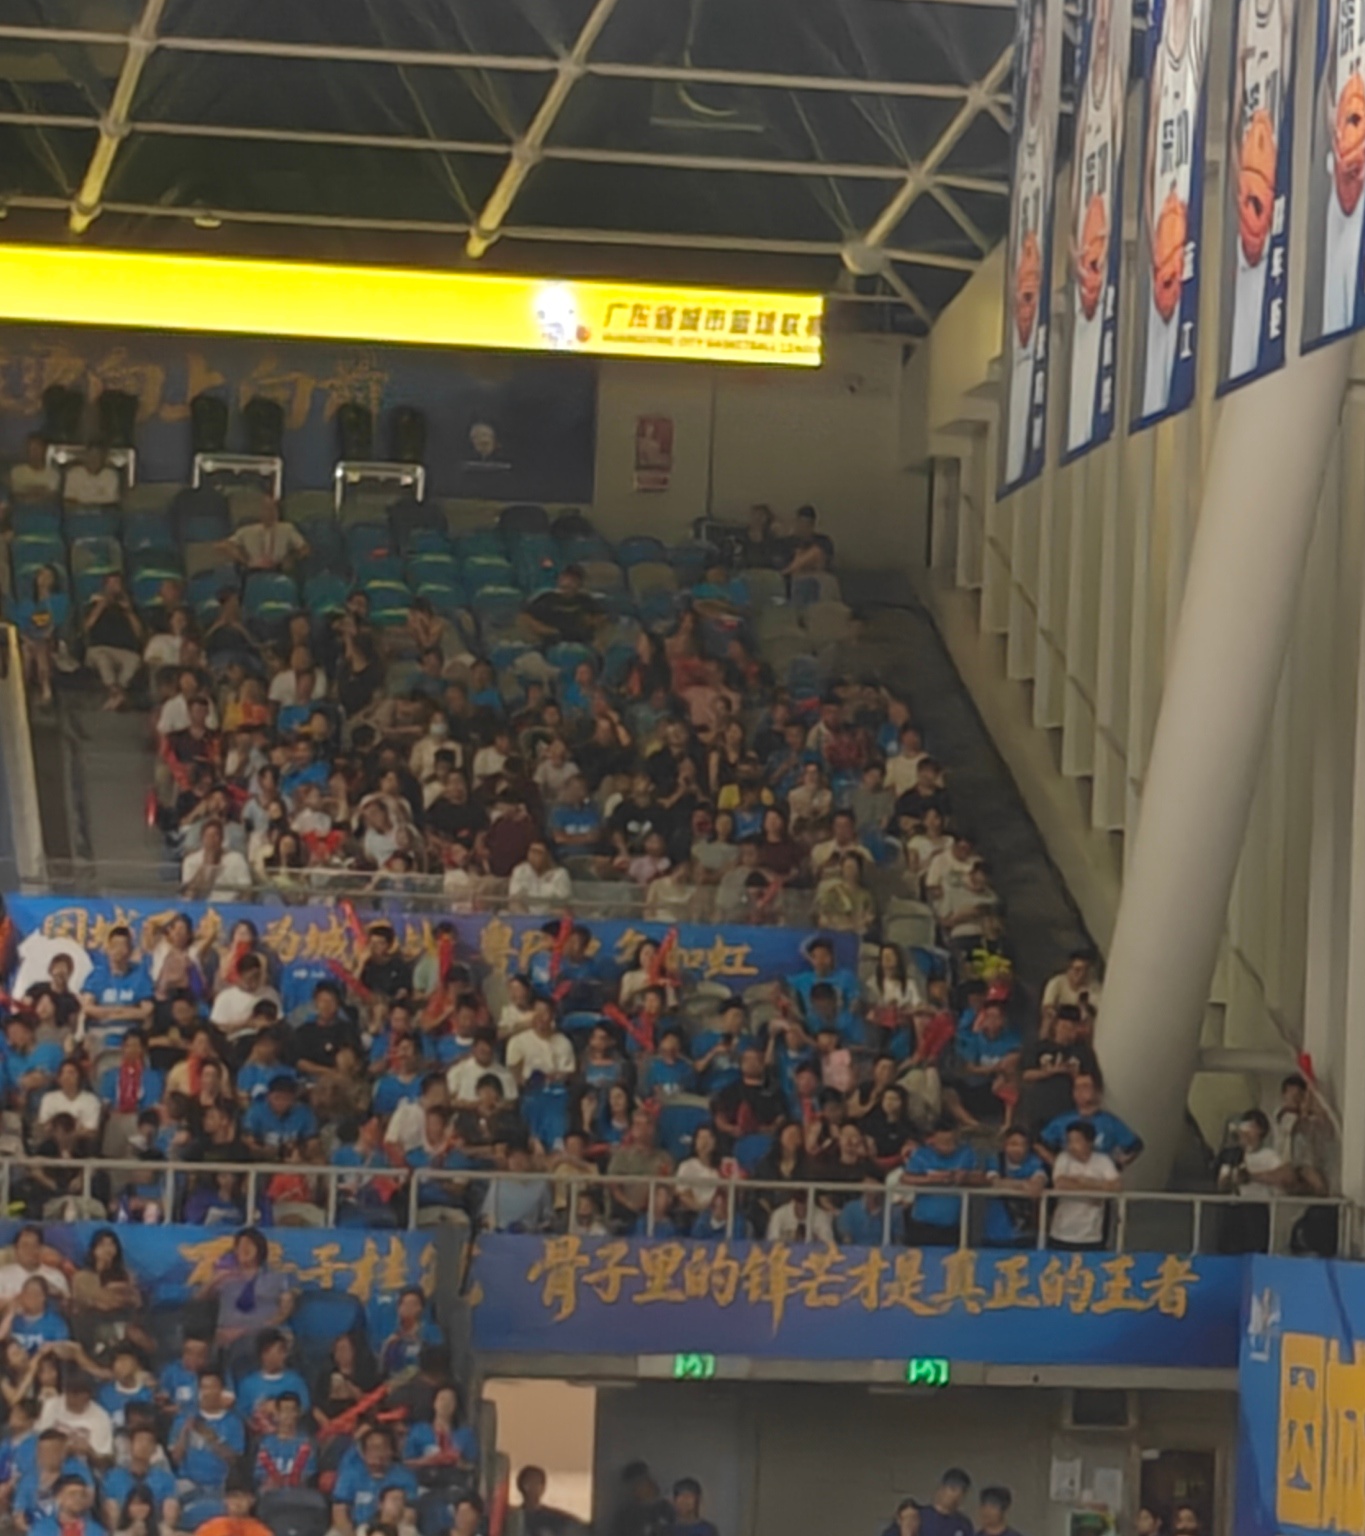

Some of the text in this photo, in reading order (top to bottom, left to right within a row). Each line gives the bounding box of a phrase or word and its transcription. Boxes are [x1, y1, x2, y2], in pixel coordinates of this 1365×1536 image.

[526, 1233, 1201, 1338] 骨子里的锋芒才是真正的王者
